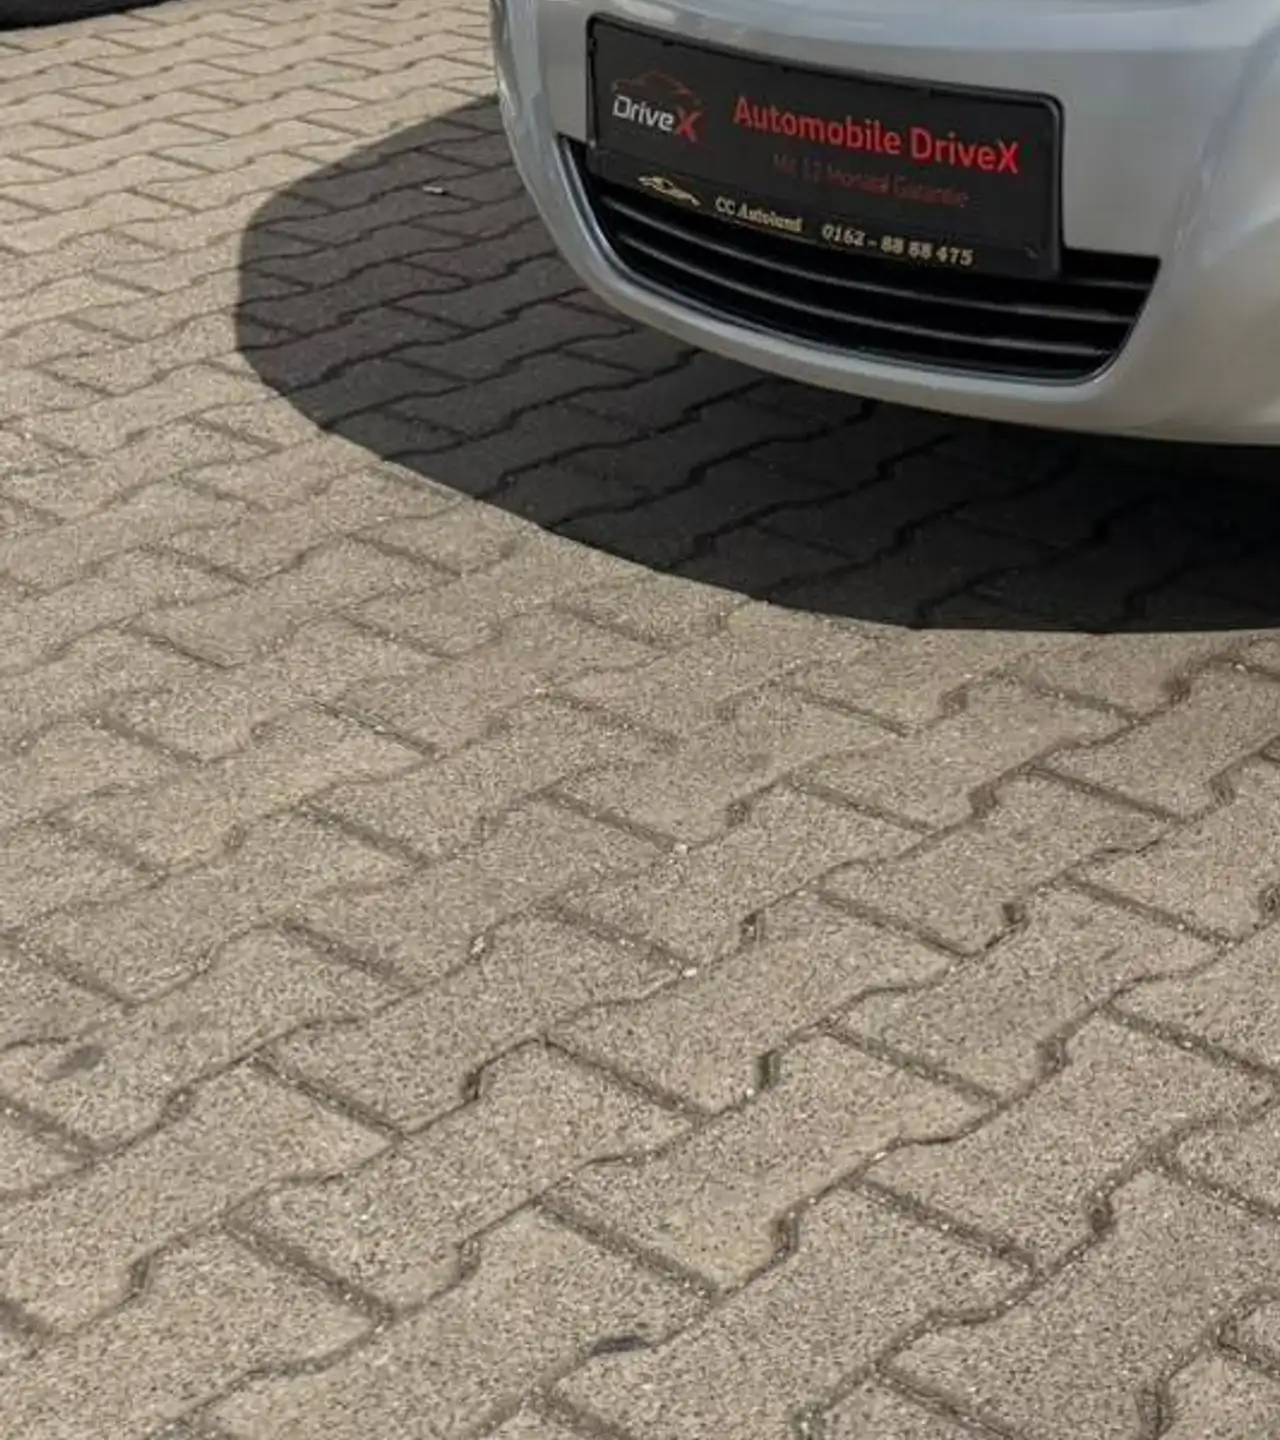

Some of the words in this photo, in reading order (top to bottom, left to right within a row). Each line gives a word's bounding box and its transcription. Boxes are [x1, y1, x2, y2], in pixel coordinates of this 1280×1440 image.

[611, 93, 702, 143] DriveX
[733, 94, 901, 156] Automobile
[909, 125, 1019, 174] DriveX
